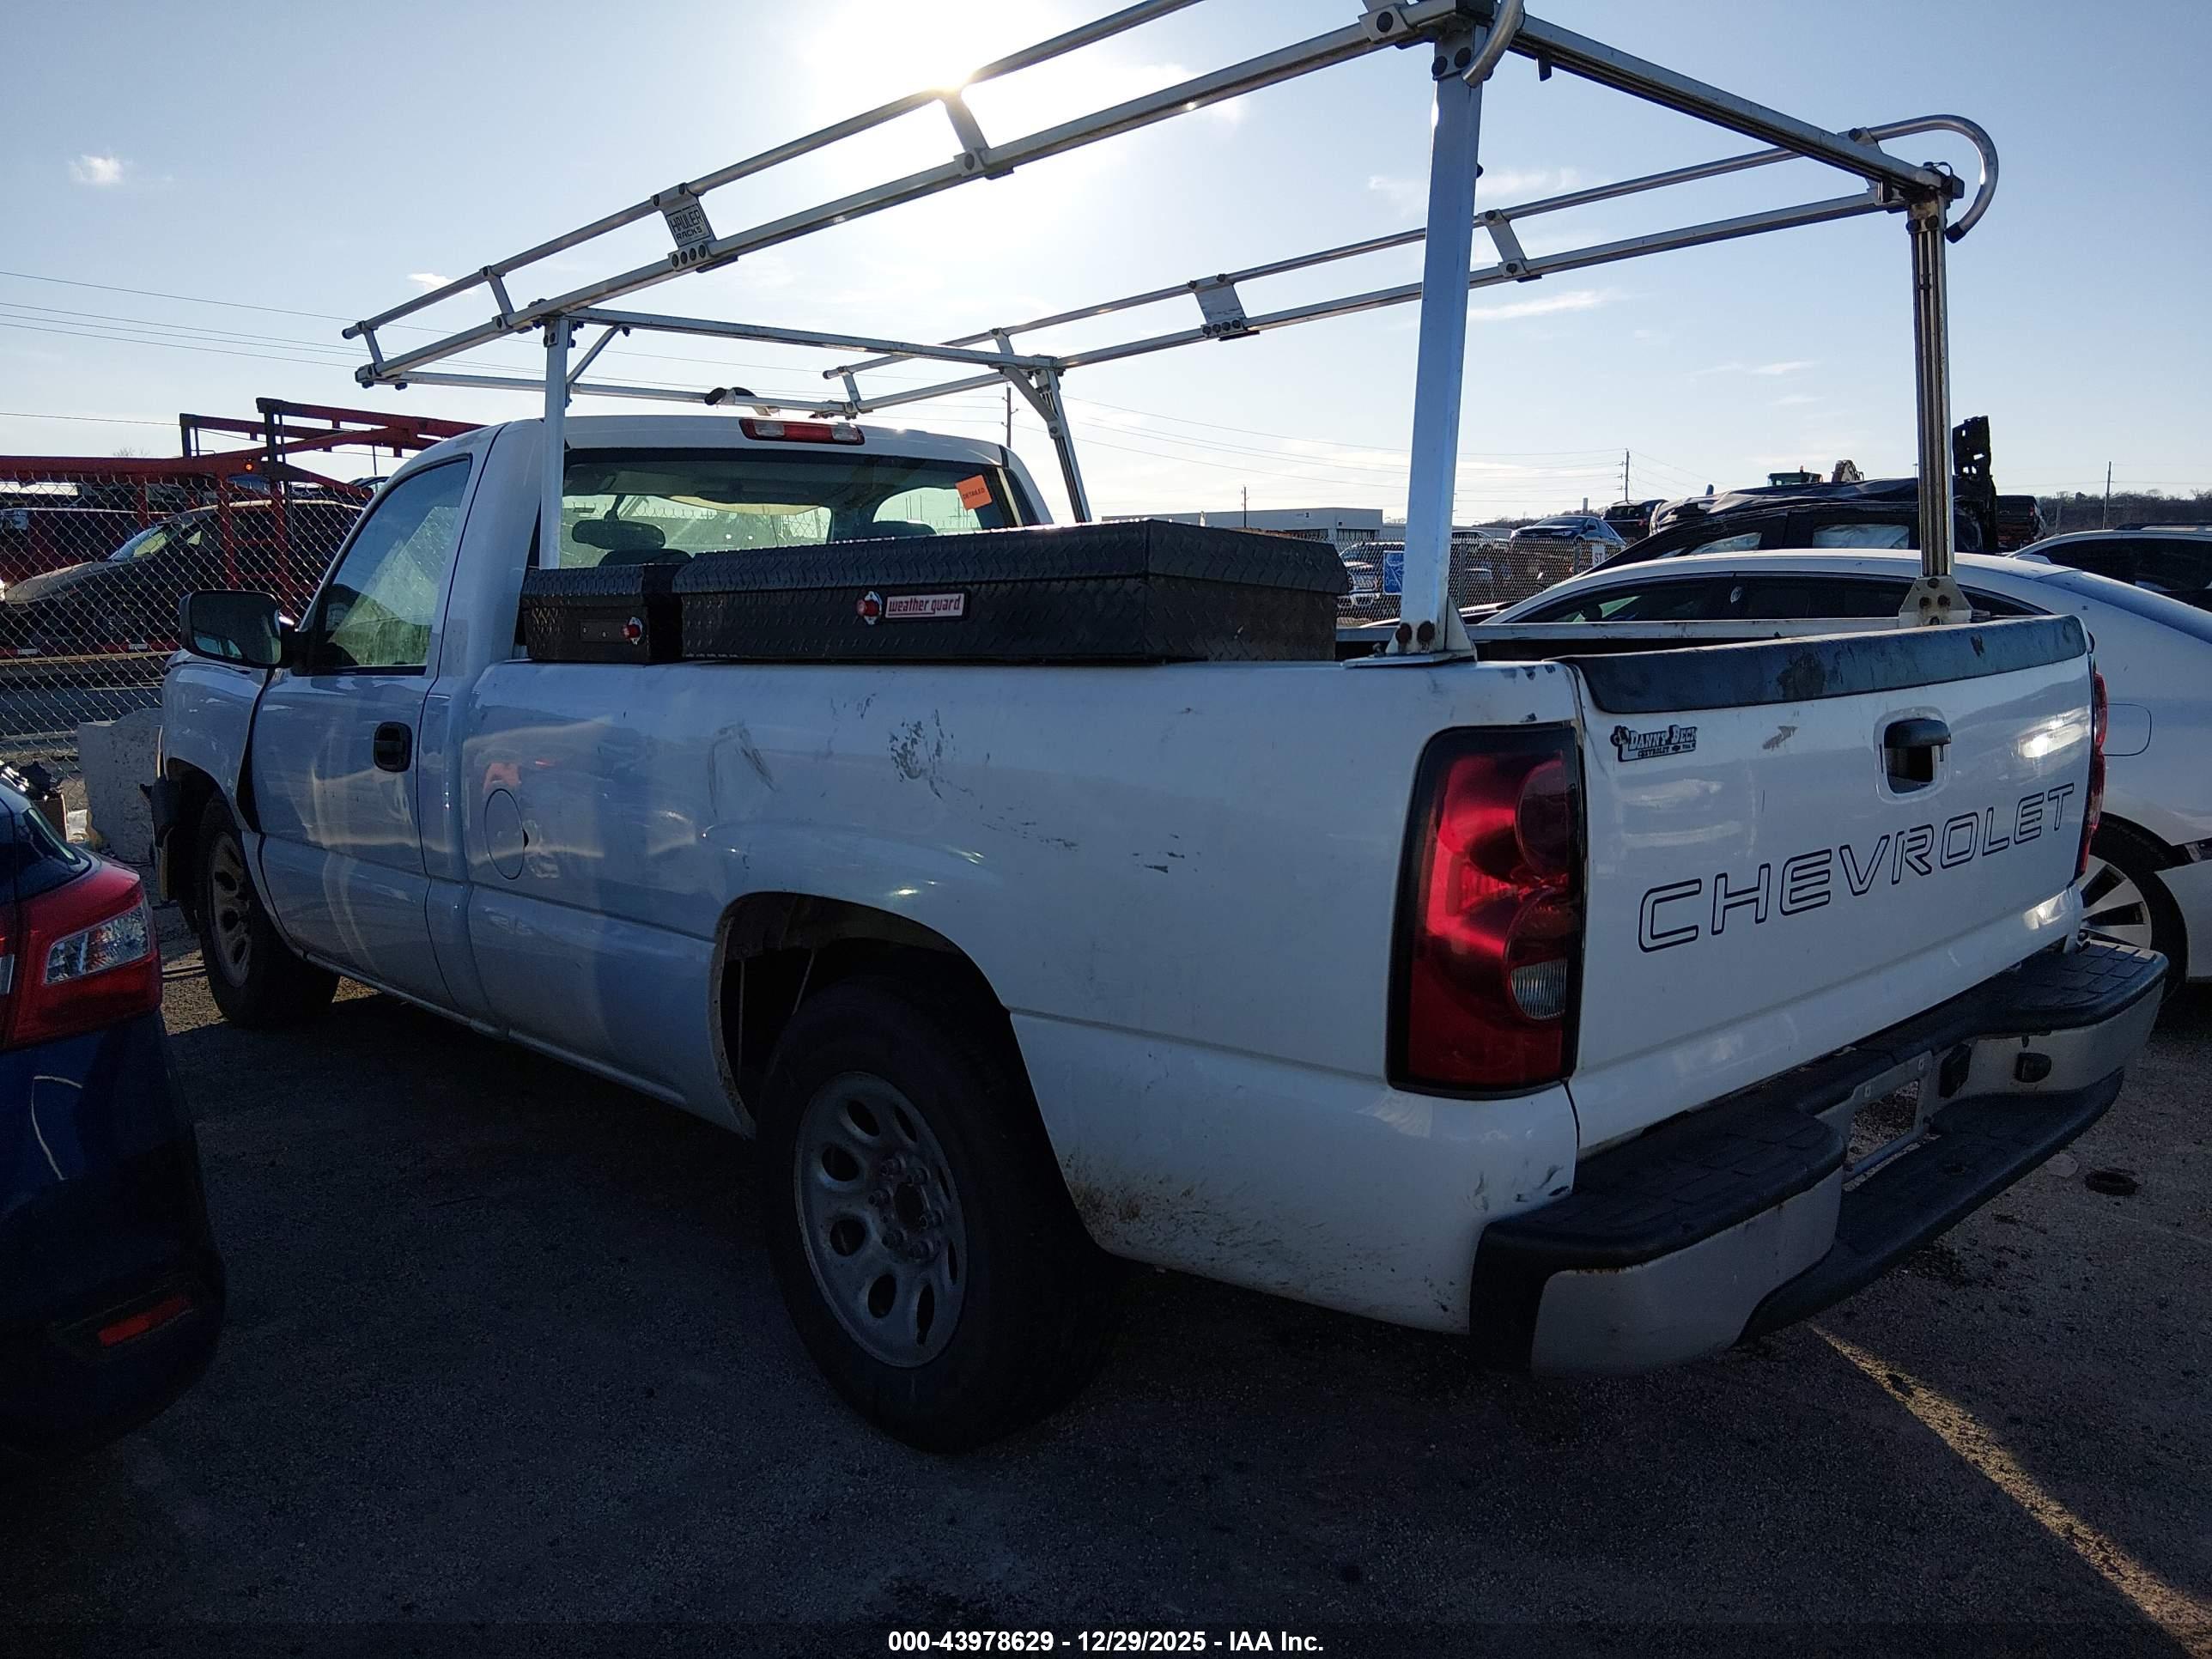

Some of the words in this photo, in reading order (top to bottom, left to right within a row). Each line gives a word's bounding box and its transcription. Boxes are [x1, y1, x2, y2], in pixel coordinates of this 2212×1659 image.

[669, 209, 704, 234] HAULER
[675, 225, 702, 241] RACKS
[889, 597, 929, 612] weather
[930, 594, 961, 615] guard
[1628, 730, 1668, 751] DANNY
[1669, 724, 1697, 745] BECK
[1638, 782, 2075, 953] CHEVROLET
